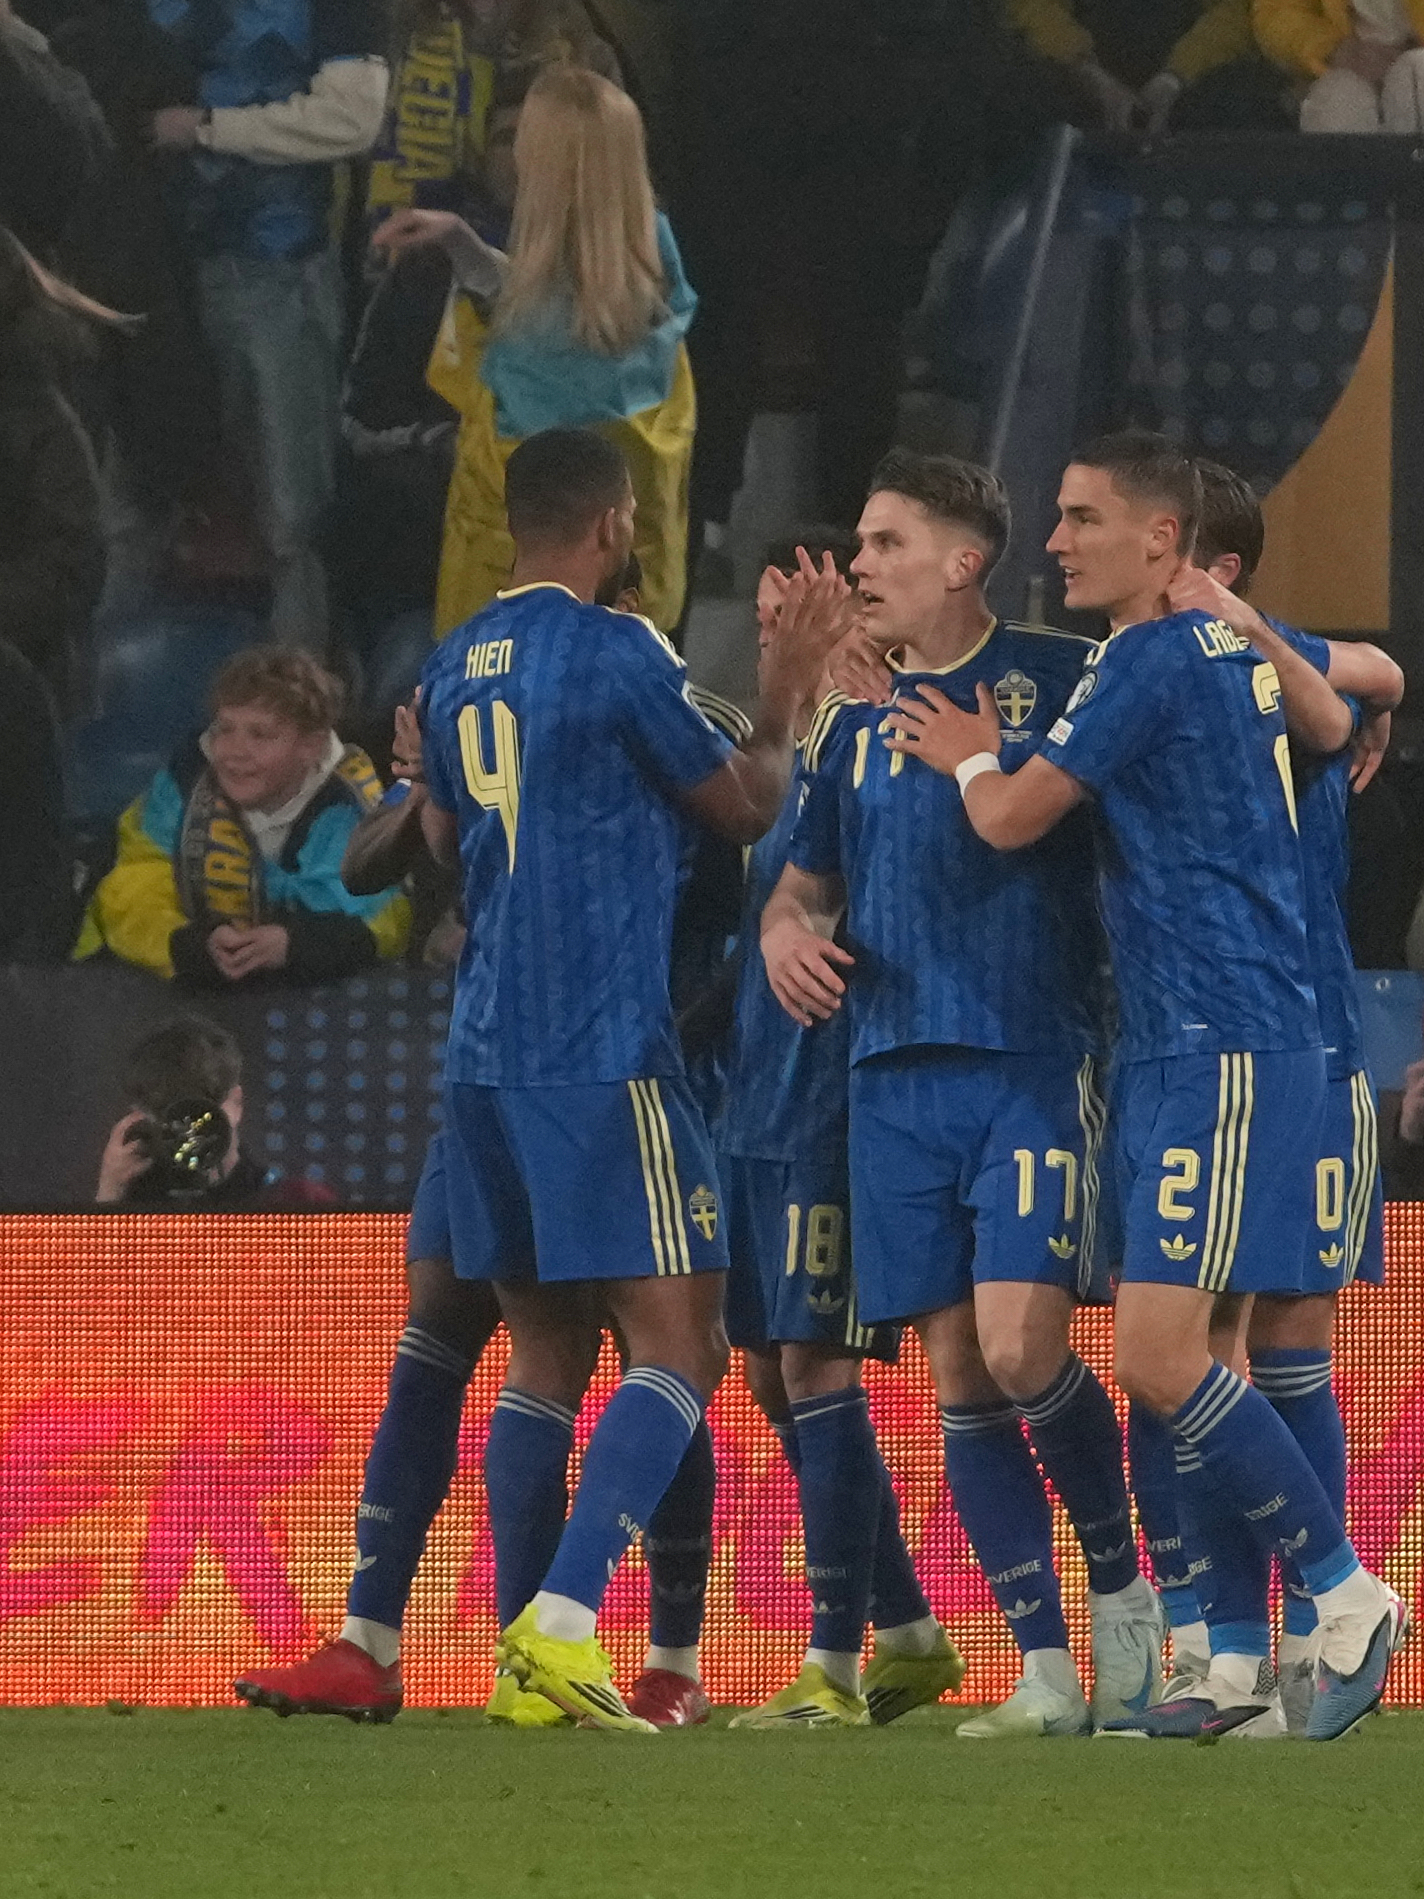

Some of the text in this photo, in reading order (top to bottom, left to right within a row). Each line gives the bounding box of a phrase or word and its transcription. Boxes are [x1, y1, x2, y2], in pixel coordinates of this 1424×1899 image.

[457, 699, 520, 877] 4
[1013, 1147, 1078, 1222] 17
[1157, 1147, 1200, 1222] 2
[785, 1203, 842, 1277] 18
